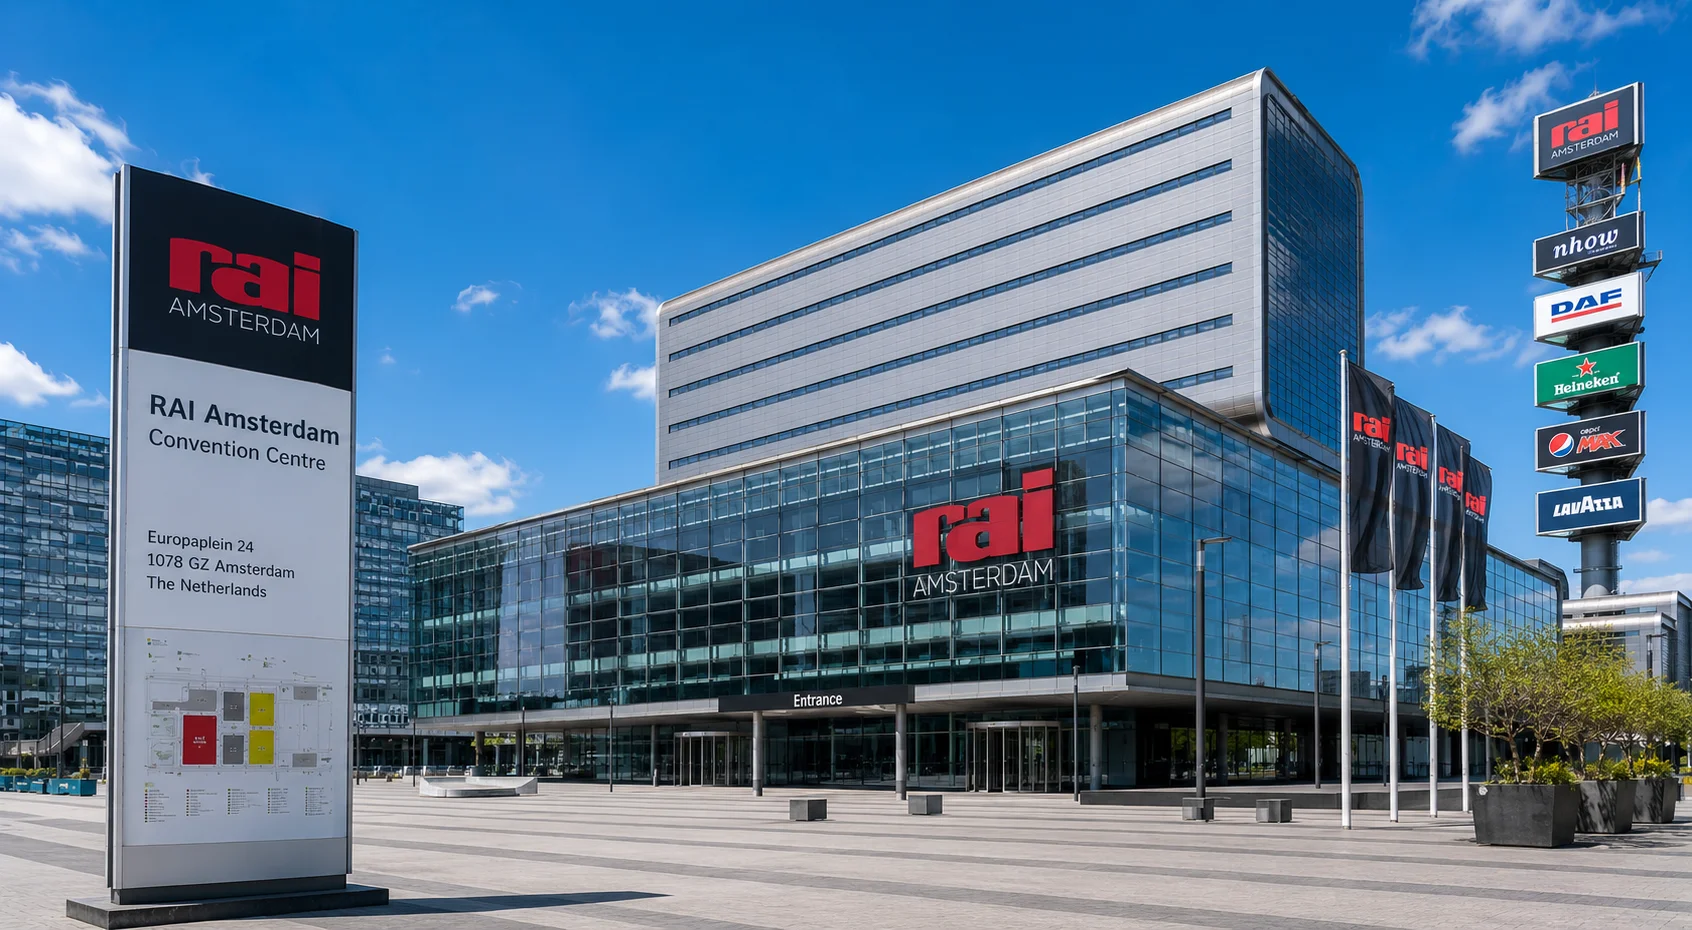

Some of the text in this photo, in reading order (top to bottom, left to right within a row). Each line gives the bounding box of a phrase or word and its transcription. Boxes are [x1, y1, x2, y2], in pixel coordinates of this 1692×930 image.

[1551, 99, 1619, 149] rai
[1551, 131, 1619, 160] AMSTERDAM
[1553, 229, 1619, 259] nhow
[169, 237, 321, 321] rai
[1551, 288, 1622, 316] DAF
[168, 297, 320, 345] AMSTERDAM
[1554, 373, 1620, 396] Heineken
[150, 394, 340, 446] RAI Amsterdam
[1353, 411, 1391, 443] rai
[149, 428, 326, 471] Convention Centre
[1576, 429, 1627, 454] MAX
[1396, 442, 1429, 471] rai
[1438, 466, 1463, 493] rai
[913, 467, 1054, 568] rai
[1465, 491, 1487, 516] rai
[148, 530, 254, 553] Europaplein 24
[147, 553, 295, 579] 1078 GZ Amsterdam
[912, 559, 1053, 598] AMSTERDAM
[146, 575, 267, 598] The Netherlands
[793, 693, 843, 708] Entrance
